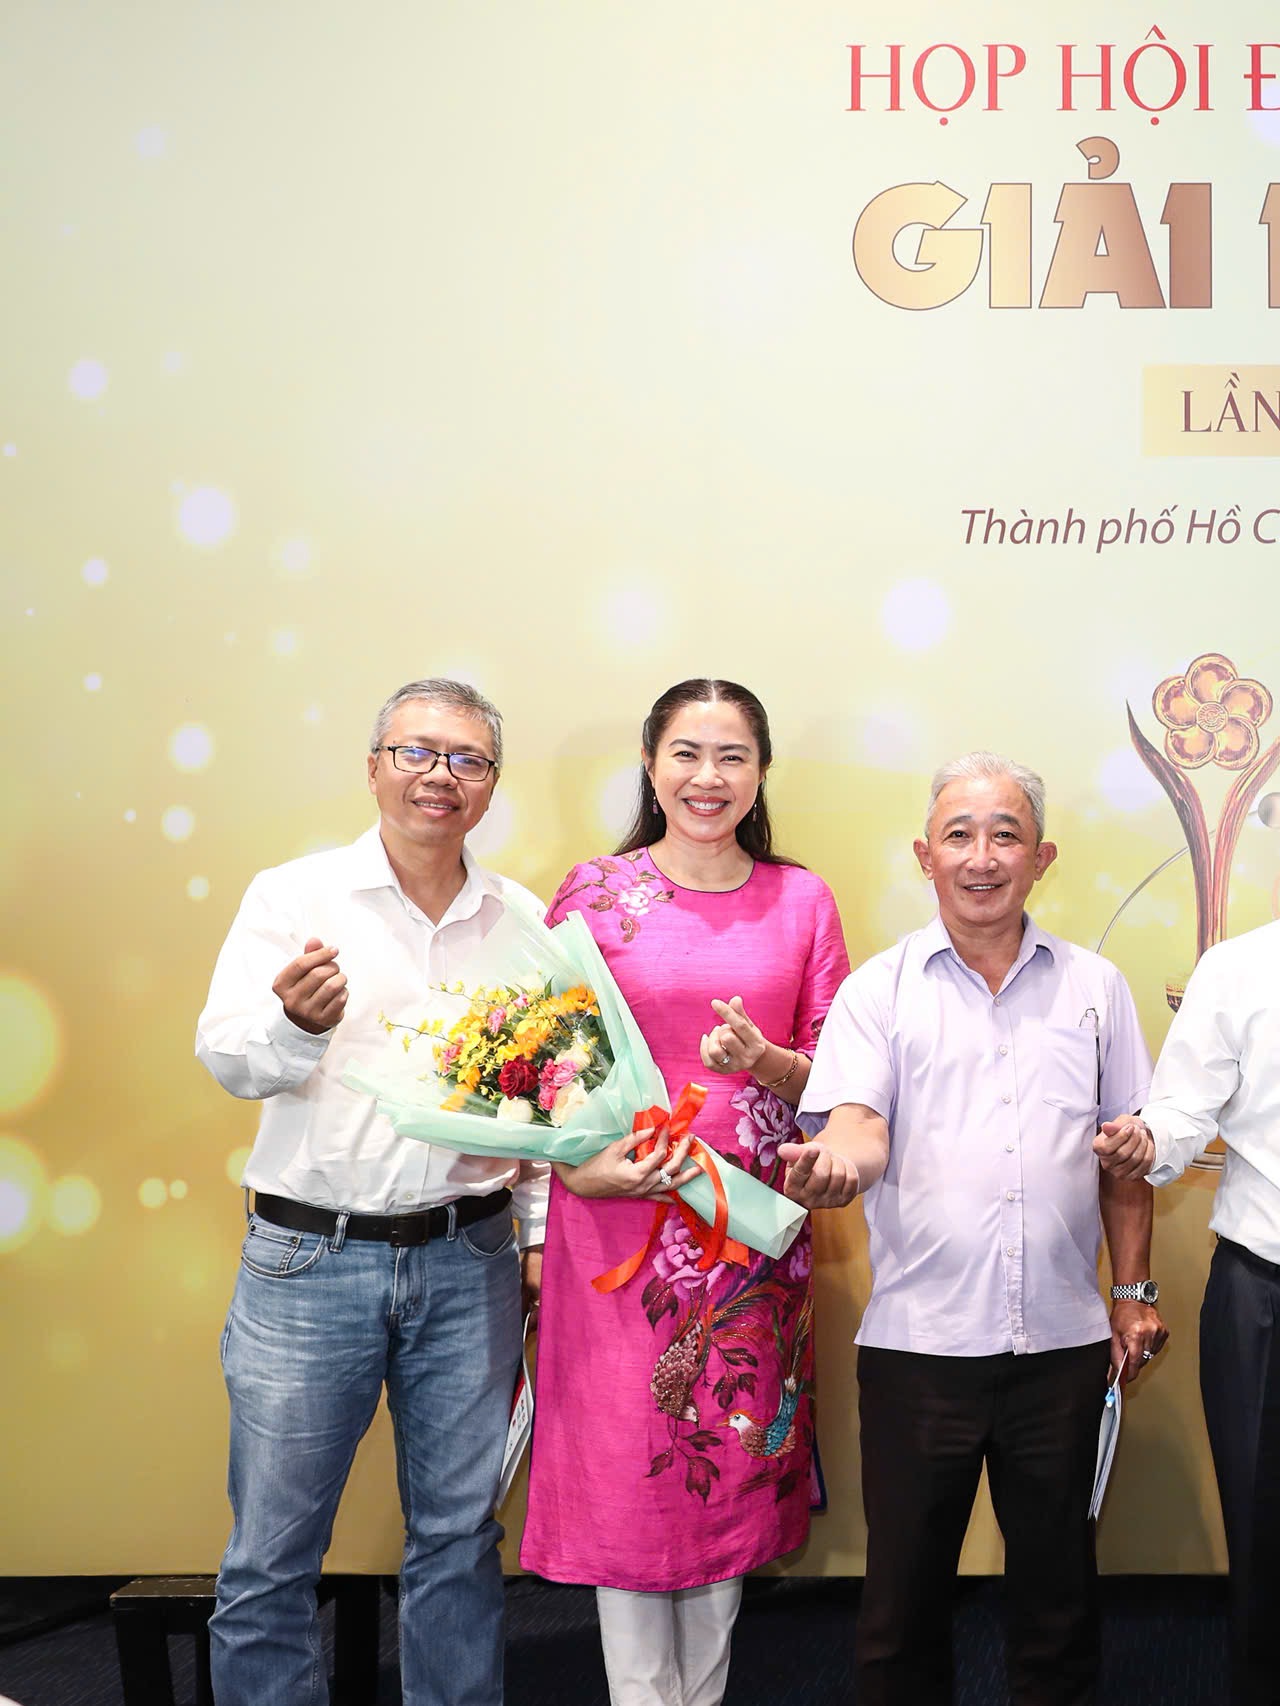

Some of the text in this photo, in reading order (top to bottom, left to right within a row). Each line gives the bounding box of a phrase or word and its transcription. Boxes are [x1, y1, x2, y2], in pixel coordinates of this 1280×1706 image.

[845, 43, 1027, 126] HỌP
[1056, 24, 1214, 126] HỘI
[852, 136, 1213, 311] GIẢI
[961, 508, 1086, 545] Thành
[1096, 504, 1178, 554] phố
[1186, 504, 1241, 544] Hồ
